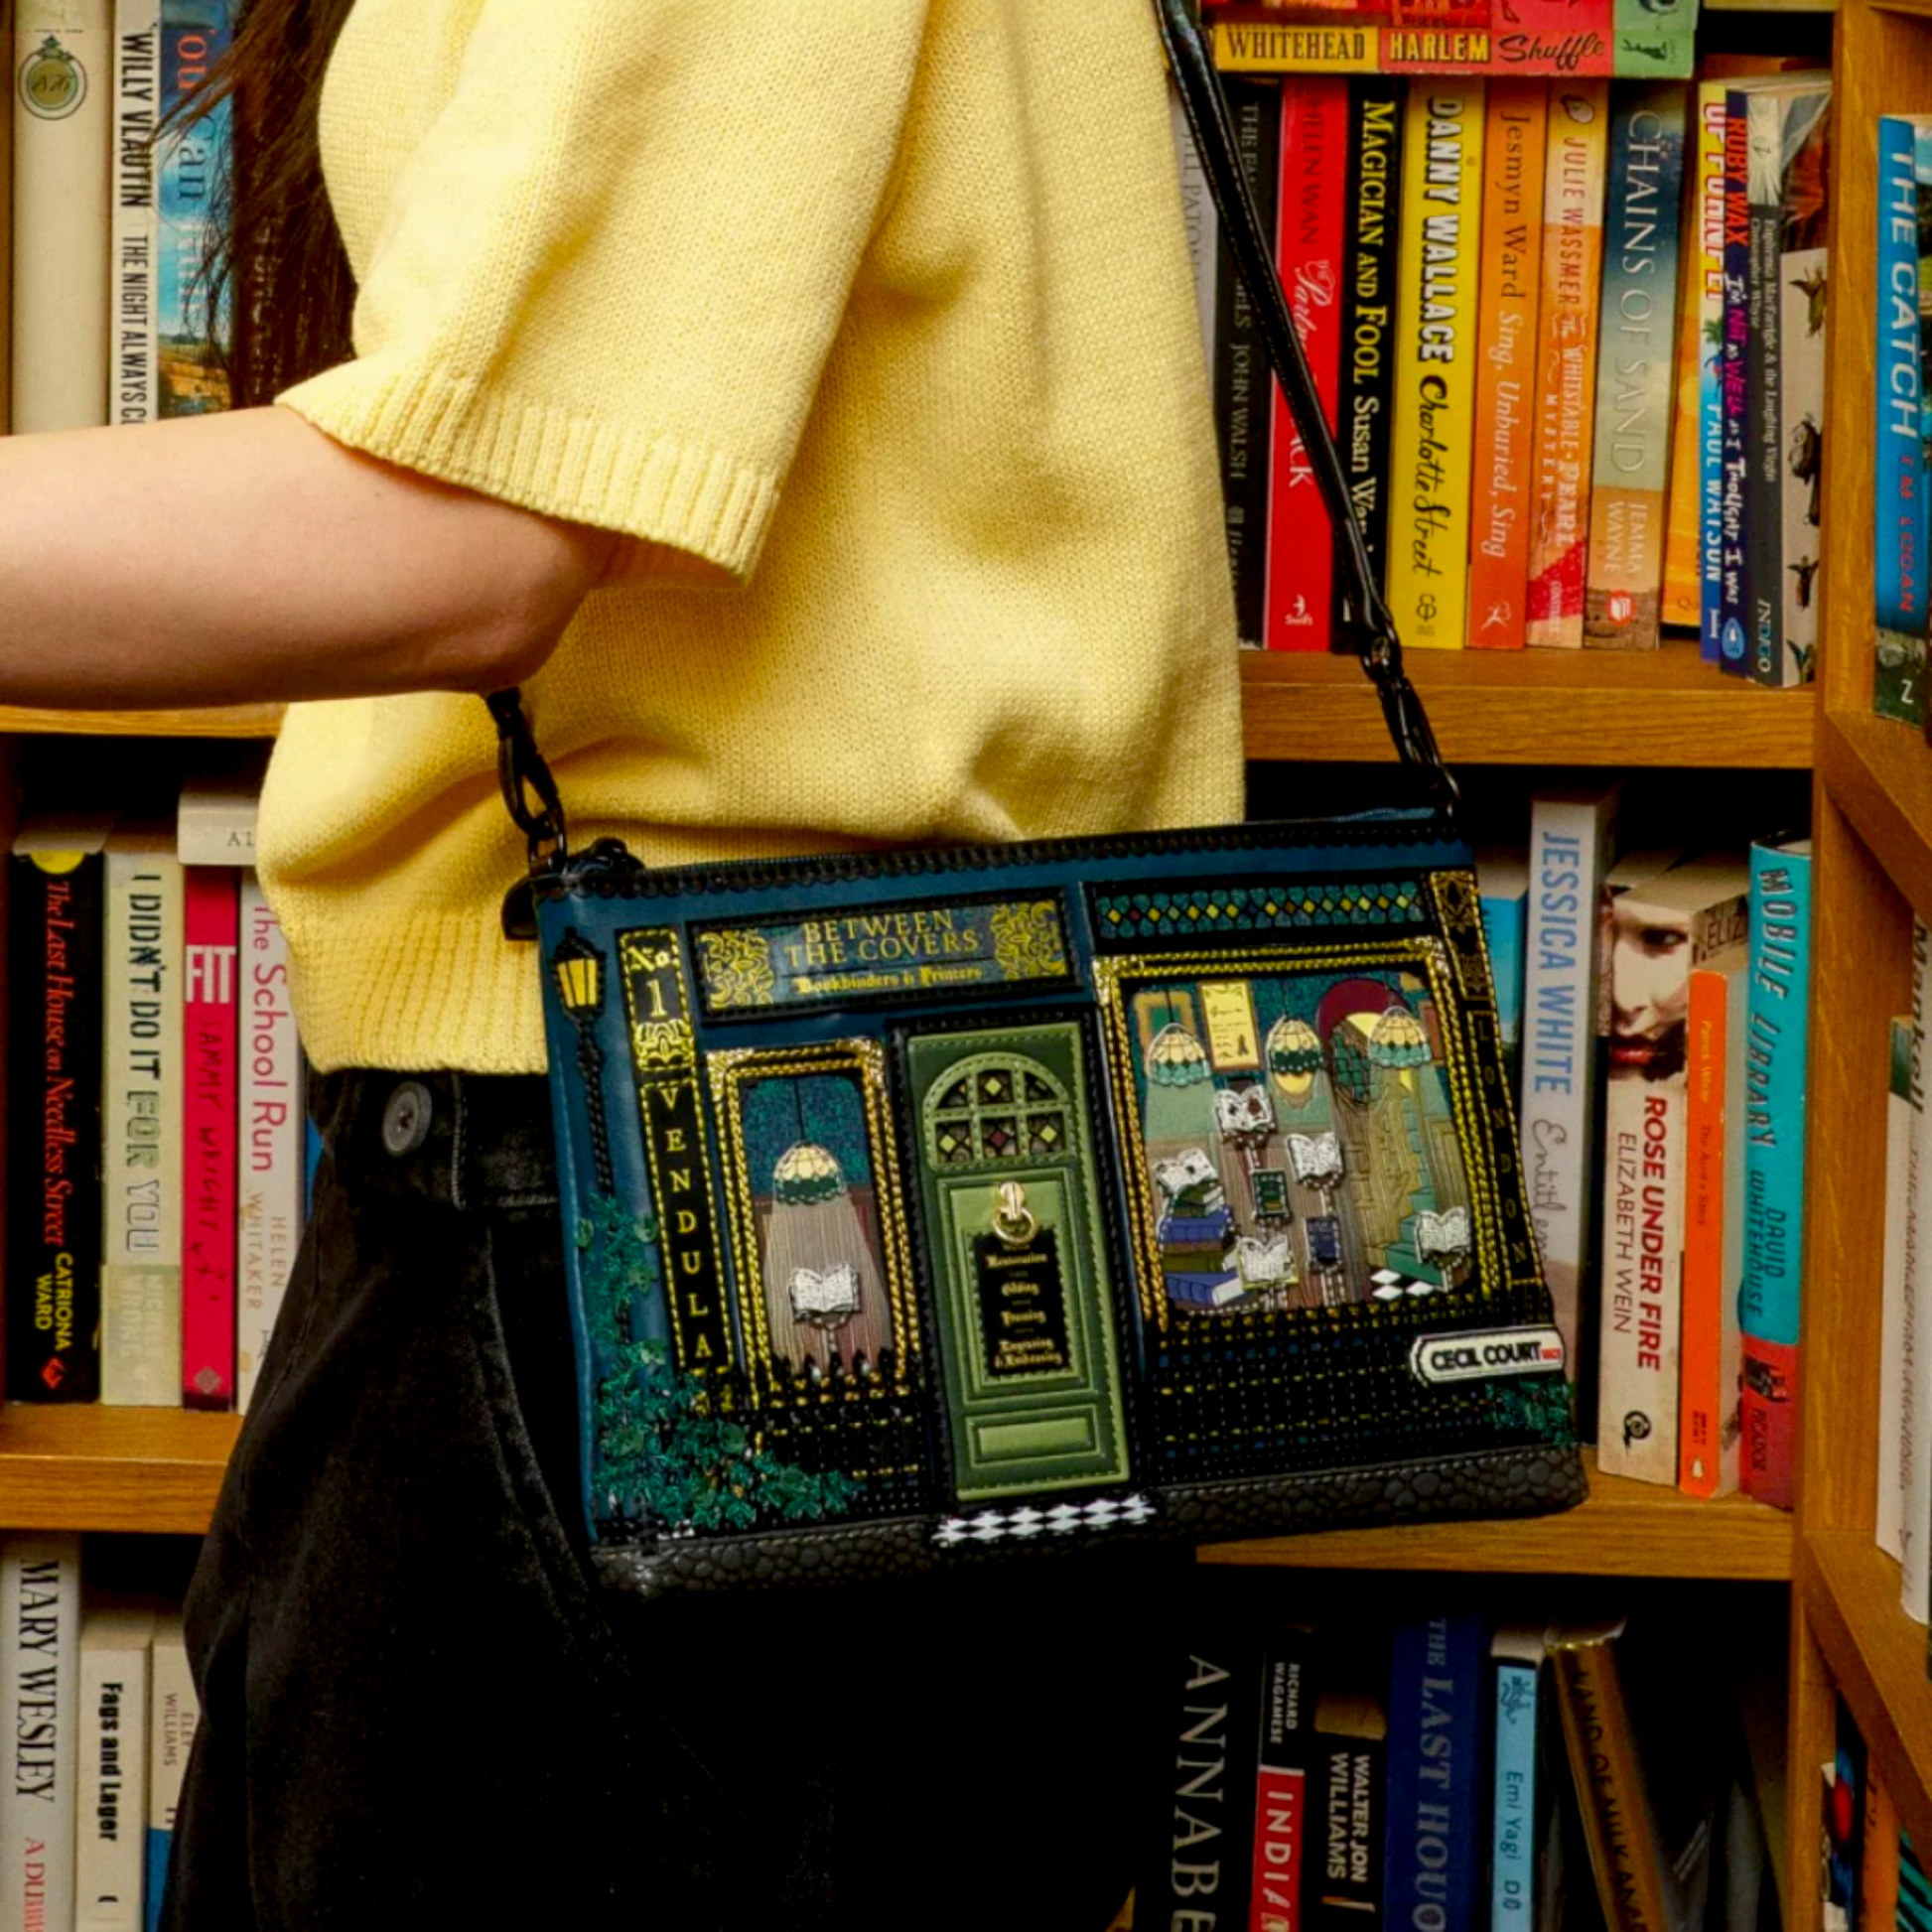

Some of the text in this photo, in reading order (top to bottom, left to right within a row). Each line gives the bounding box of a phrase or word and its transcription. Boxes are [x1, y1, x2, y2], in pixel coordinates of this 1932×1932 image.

[121, 33, 154, 101] WILLY
[178, 29, 216, 89] ou
[1227, 31, 1606, 70] WHITEHEAD HARLEM Shuffle
[120, 110, 154, 207] VLAUTIN
[1563, 139, 1587, 198] JULIE
[1726, 118, 1747, 185] RUBY
[122, 235, 148, 268] THE
[1558, 207, 1584, 304] WASSMER
[1726, 192, 1747, 247] WAX
[121, 272, 147, 326] NIGHT
[1351, 99, 1395, 474] MAGICIAN AND FOOL Susan
[1609, 110, 1662, 474] CHAINS OF SAND
[1748, 218, 1761, 328] Christopher Whyte
[121, 331, 147, 402] ALWAYS
[1413, 97, 1464, 578] DANNY WALLACE Charlotte Street
[1481, 112, 1530, 558] Jesmyn Ward Sing, Unburied, Sing
[1232, 344, 1250, 402] JOHN
[1890, 146, 1917, 613] THE CATCH LOGAN
[1230, 408, 1249, 478] WALSH
[1762, 391, 1776, 443] Laughing
[1763, 448, 1776, 483] Virgin
[1604, 499, 1625, 572] WAYNE
[1628, 503, 1648, 574] JEMMA
[1756, 599, 1772, 673] INDIGO
[129, 894, 168, 993] DIDN'T
[785, 929, 979, 967] THE COVERS
[802, 908, 954, 944] BETWEEN
[1535, 831, 1580, 1095] JESSICA WHITE
[129, 1000, 161, 1038] DO
[253, 962, 288, 1087] School
[1747, 868, 1798, 1148] MOBILE LIBRARY
[44, 880, 76, 1246] The Last House on Needless Street
[129, 1048, 161, 1080] IT
[186, 945, 237, 1230] FIT SAMMY WRIGHT
[126, 1089, 161, 1169] FOR
[252, 1101, 288, 1172] Run
[126, 1178, 160, 1252] YOU
[247, 1191, 263, 1309] WHITAKER
[270, 1216, 287, 1288] HELEN
[659, 1089, 715, 1357] VENDULA
[1614, 1132, 1637, 1333] ELIZABETH WEIN
[1638, 1095, 1667, 1370] ROSE UNDER FIRE
[1747, 1170, 1766, 1317] WHITEHOUSE
[1764, 1207, 1787, 1279] DAVID
[35, 1273, 54, 1330] WARD
[54, 1252, 73, 1350] CATRIONA
[1431, 1347, 1482, 1371] CECIL
[1483, 1341, 1542, 1365] COURT
[18, 1559, 59, 1657] MARY
[1427, 1618, 1448, 1666] THE
[164, 1694, 178, 1766] WILLIAMS
[181, 1713, 195, 1747] ELEY
[1270, 1662, 1286, 1744] WAGAMESE
[1285, 1663, 1300, 1729] RICHARD
[1418, 1676, 1454, 1790] LAST
[16, 1665, 58, 1803] WESLEY
[97, 1683, 123, 1841] Fags and Lager
[25, 1838, 45, 1856] A
[1326, 1751, 1348, 1879] WILLIAMS
[1350, 1754, 1370, 1883] WALTER JON
[1500, 1771, 1523, 1861] Emi Yagi
